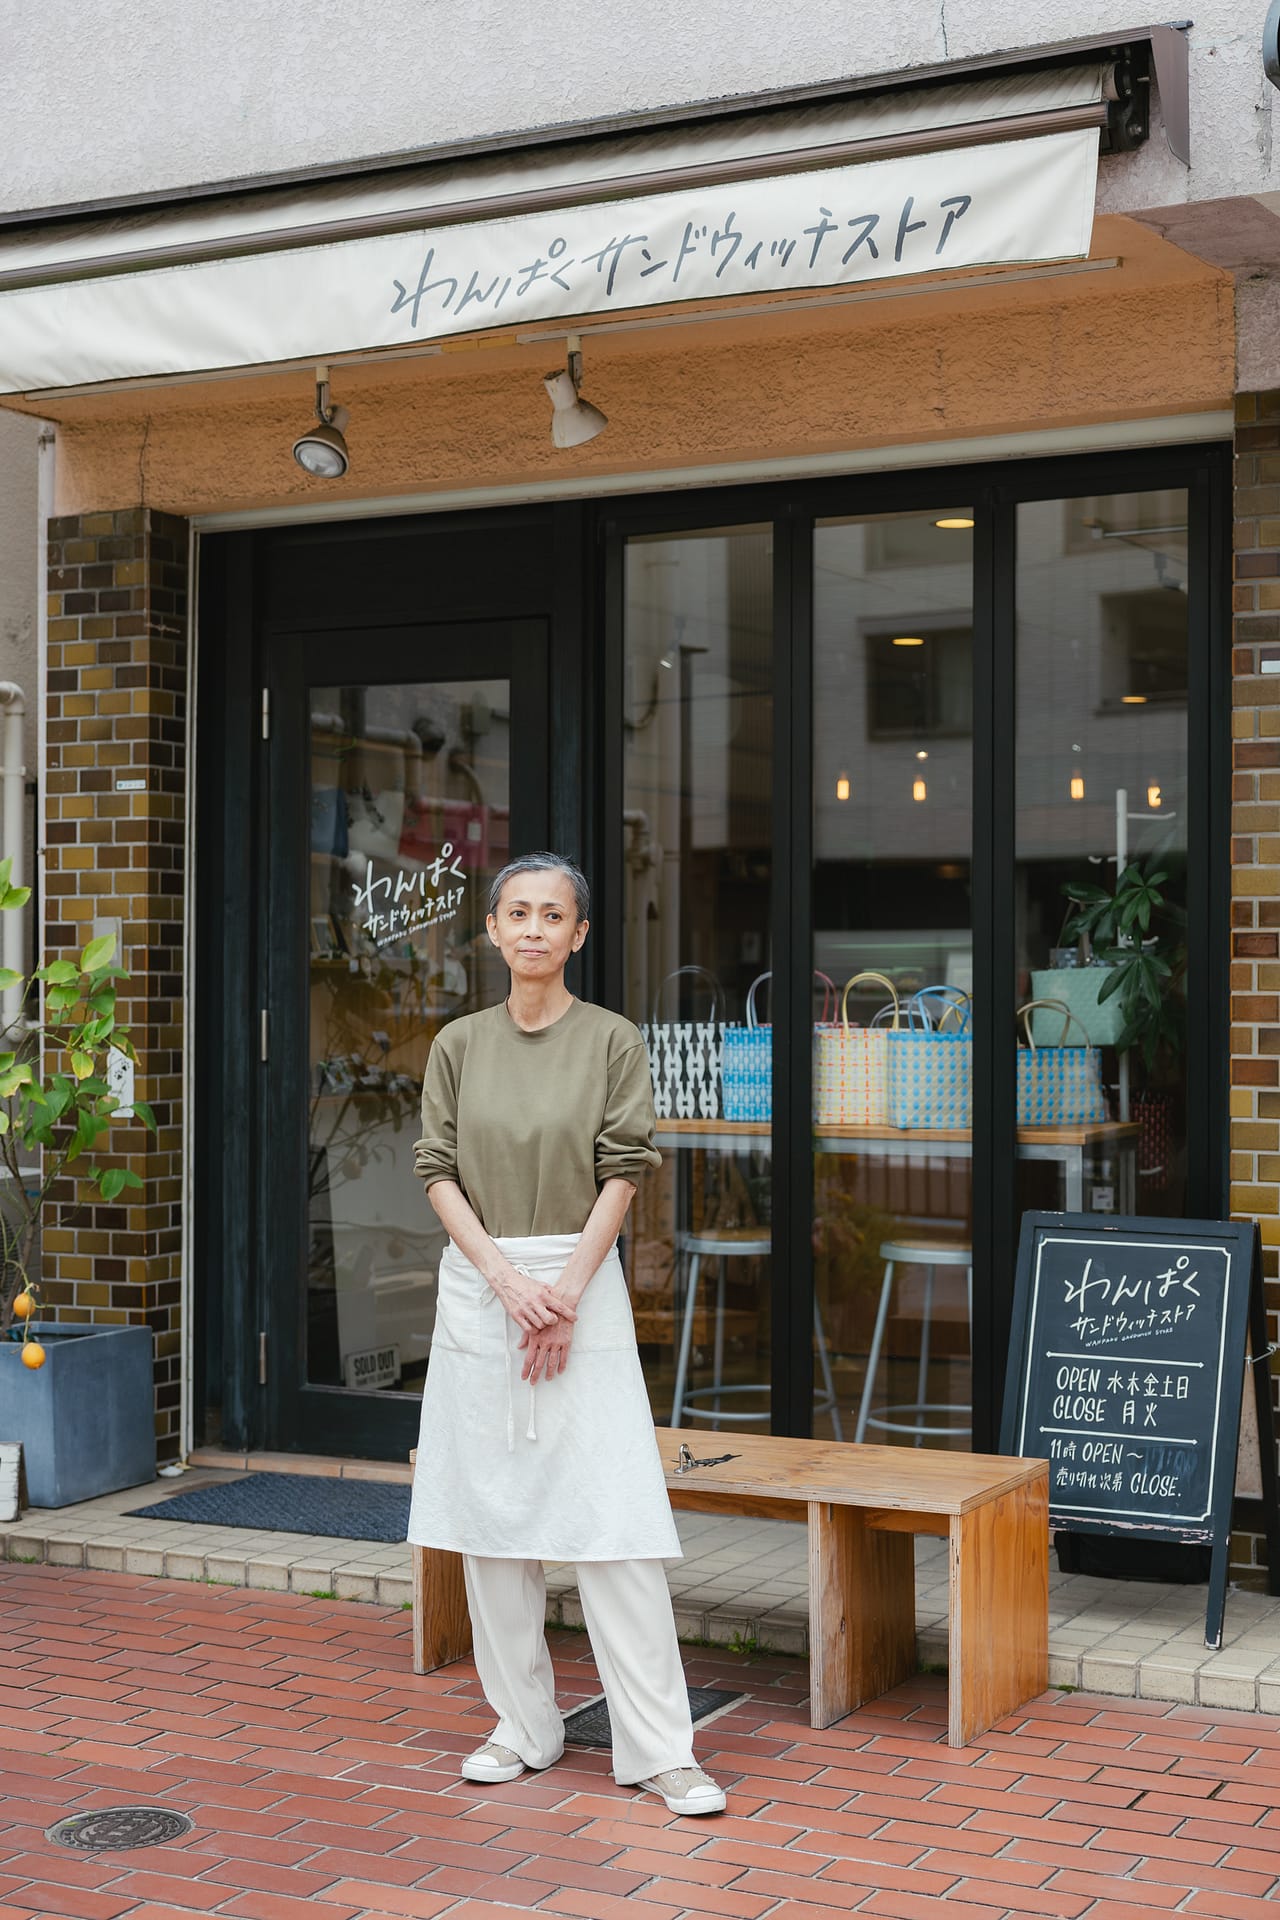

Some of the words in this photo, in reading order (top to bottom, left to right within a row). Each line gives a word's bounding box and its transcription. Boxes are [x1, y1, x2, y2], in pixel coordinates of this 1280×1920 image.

[352, 842, 467, 914] わんぱく
[362, 886, 465, 939] サンドウィッチストア
[1064, 1255, 1200, 1313] わんぱく
[1070, 1304, 1196, 1340] サンドウィッチストア
[354, 1354, 377, 1377] SOLD
[377, 1349, 394, 1371] OUT
[1056, 1366, 1101, 1393] OPEN
[1106, 1370, 1189, 1400] 水木金土日
[1052, 1395, 1107, 1422] CLOSE
[1050, 1438, 1077, 1461] 11時
